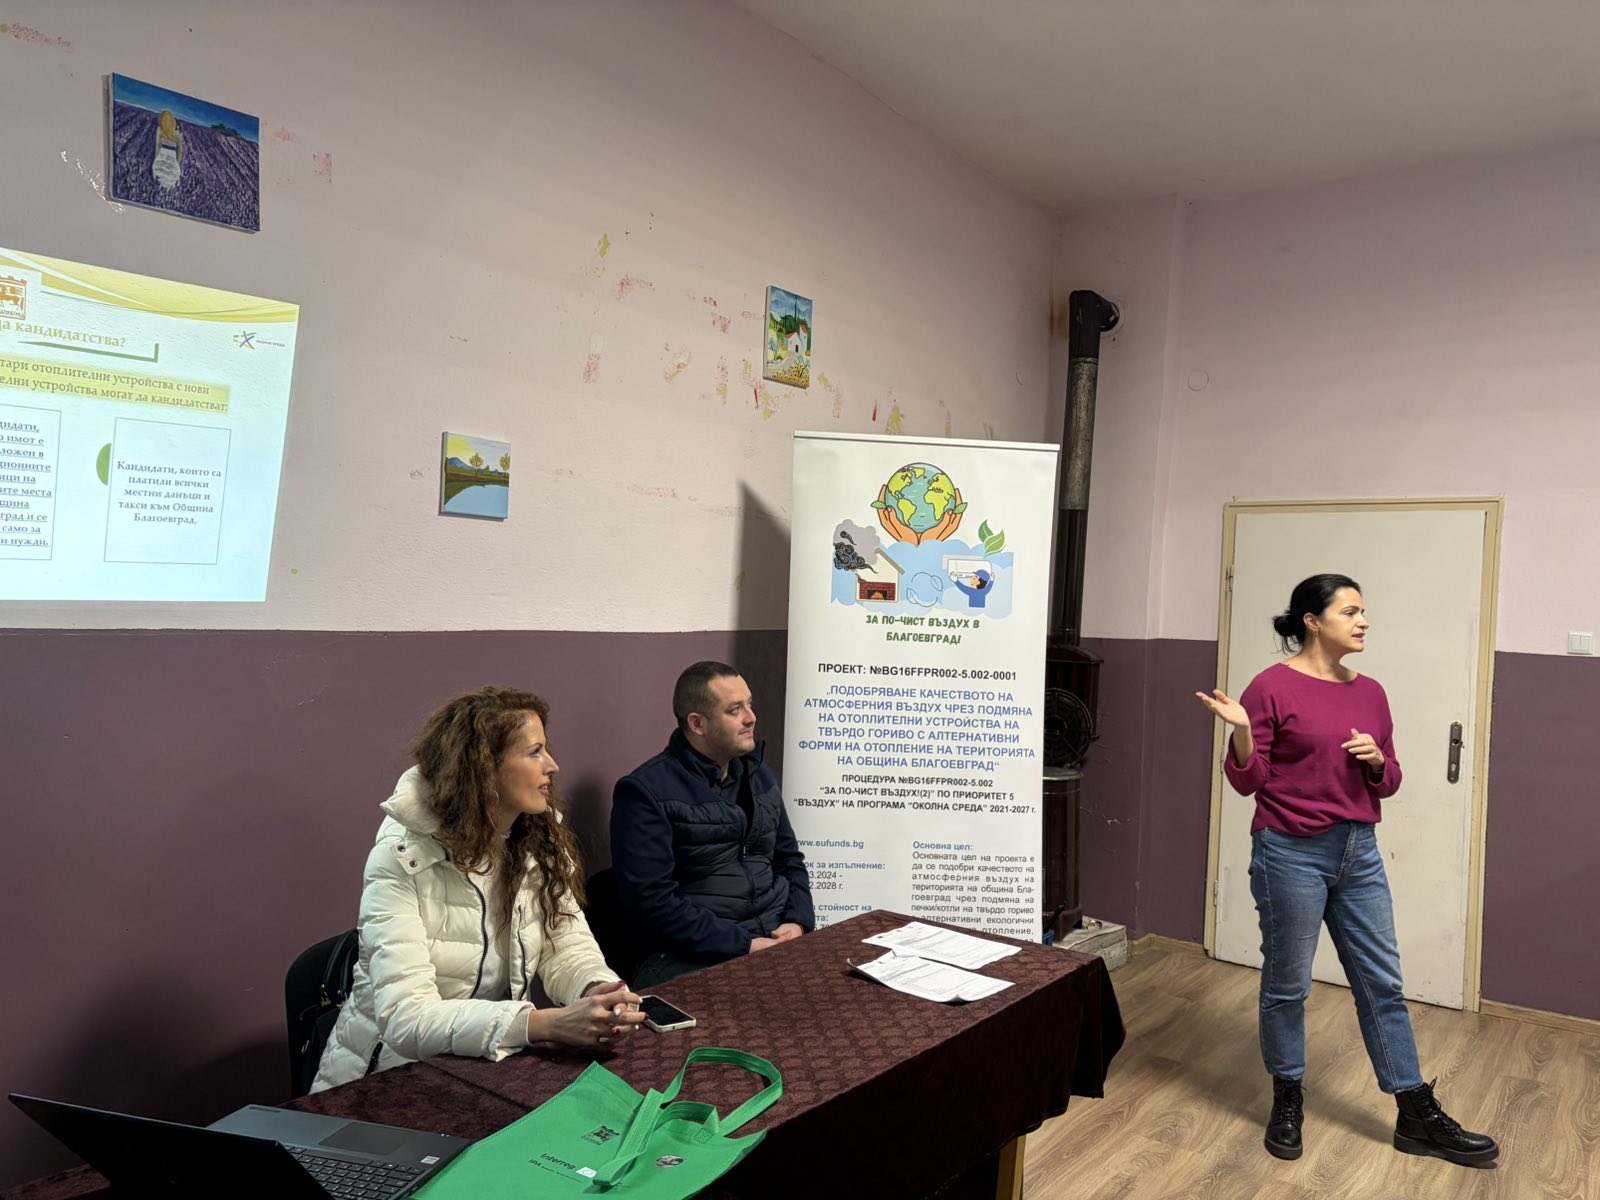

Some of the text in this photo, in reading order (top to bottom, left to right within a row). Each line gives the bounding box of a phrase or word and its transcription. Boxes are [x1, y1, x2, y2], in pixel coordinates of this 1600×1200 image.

[0, 320, 126, 347] а кандидатства?
[0, 359, 209, 395] тари отоплителни устройства с нови
[0, 375, 29, 387] елни
[32, 379, 98, 397] устройства
[100, 389, 133, 400] могат
[135, 393, 148, 402] да
[117, 461, 178, 474] Кандидати,
[211, 469, 222, 477] са
[128, 476, 209, 488] платили всички
[21, 488, 52, 497] места
[124, 488, 162, 498] местни
[0, 500, 30, 508] щина
[117, 501, 214, 513] такси към Община
[0, 512, 24, 521] град
[865, 615, 980, 629] ЗА ПО-ЧИСТ ВЪЗДУХ В
[886, 631, 962, 645] БЛАГОЕВГРАД!
[818, 663, 1016, 680] ПРОЕКТ: №BG16FFPR002-5.002-0001
[826, 685, 1014, 702] „ПОДОБРЯВАНЕ КАЧЕСТВОТО НА
[804, 698, 1032, 716] АТМОСФЕРНИЯ ВЪЗДУХ ЧРЕЗ ПОДМЯНА
[818, 713, 1020, 729] НА ОТОПЛИТЕЛНИ УСТРОЙСТВА НА
[818, 726, 1020, 743] ТВЪРДО ГОРИВО С АЛТЕРНАТИВНИ
[798, 740, 1035, 758] ФОРМИ НА ОТОПЛЕНИЕ НА ТЕРИТОРИЯТА
[837, 755, 853, 765] НА
[856, 756, 908, 768] ОБЩИНА
[841, 774, 993, 787] ПРОЦЕДУРА №BG16FFPR002-5.002
[838, 786, 878, 796] ПО-ЧИСТ
[937, 790, 950, 798] ПО
[952, 790, 1007, 800] ПРИОРИТЕТ
[842, 800, 855, 808] НА
[857, 800, 906, 809] ПРОГРАМА
[989, 804, 1030, 813] 2021-2027
[797, 839, 864, 849] ww.eufunds.bg
[912, 840, 952, 850] Основна
[912, 851, 958, 860] Основната
[961, 854, 977, 862] цел
[995, 855, 1027, 863] проекта
[828, 862, 886, 870] изпълнение:
[911, 862, 923, 870] да
[938, 862, 974, 872] подобри
[809, 870, 837, 879] 3.2024
[911, 872, 980, 882] атмосферния
[985, 875, 1020, 884] въздух
[809, 881, 837, 890] 2.2028
[911, 883, 964, 893] територията
[980, 885, 1014, 895] община
[911, 894, 951, 904] гоевград
[955, 895, 977, 904] чрез
[981, 896, 1020, 904] подмяна
[818, 903, 860, 911] стойност
[911, 903, 960, 913] печки/котли
[976, 906, 1006, 914] твърдо
[1007, 907, 1035, 915] гориво
[921, 914, 982, 923] алтернативни
[986, 917, 1034, 925] екологични
